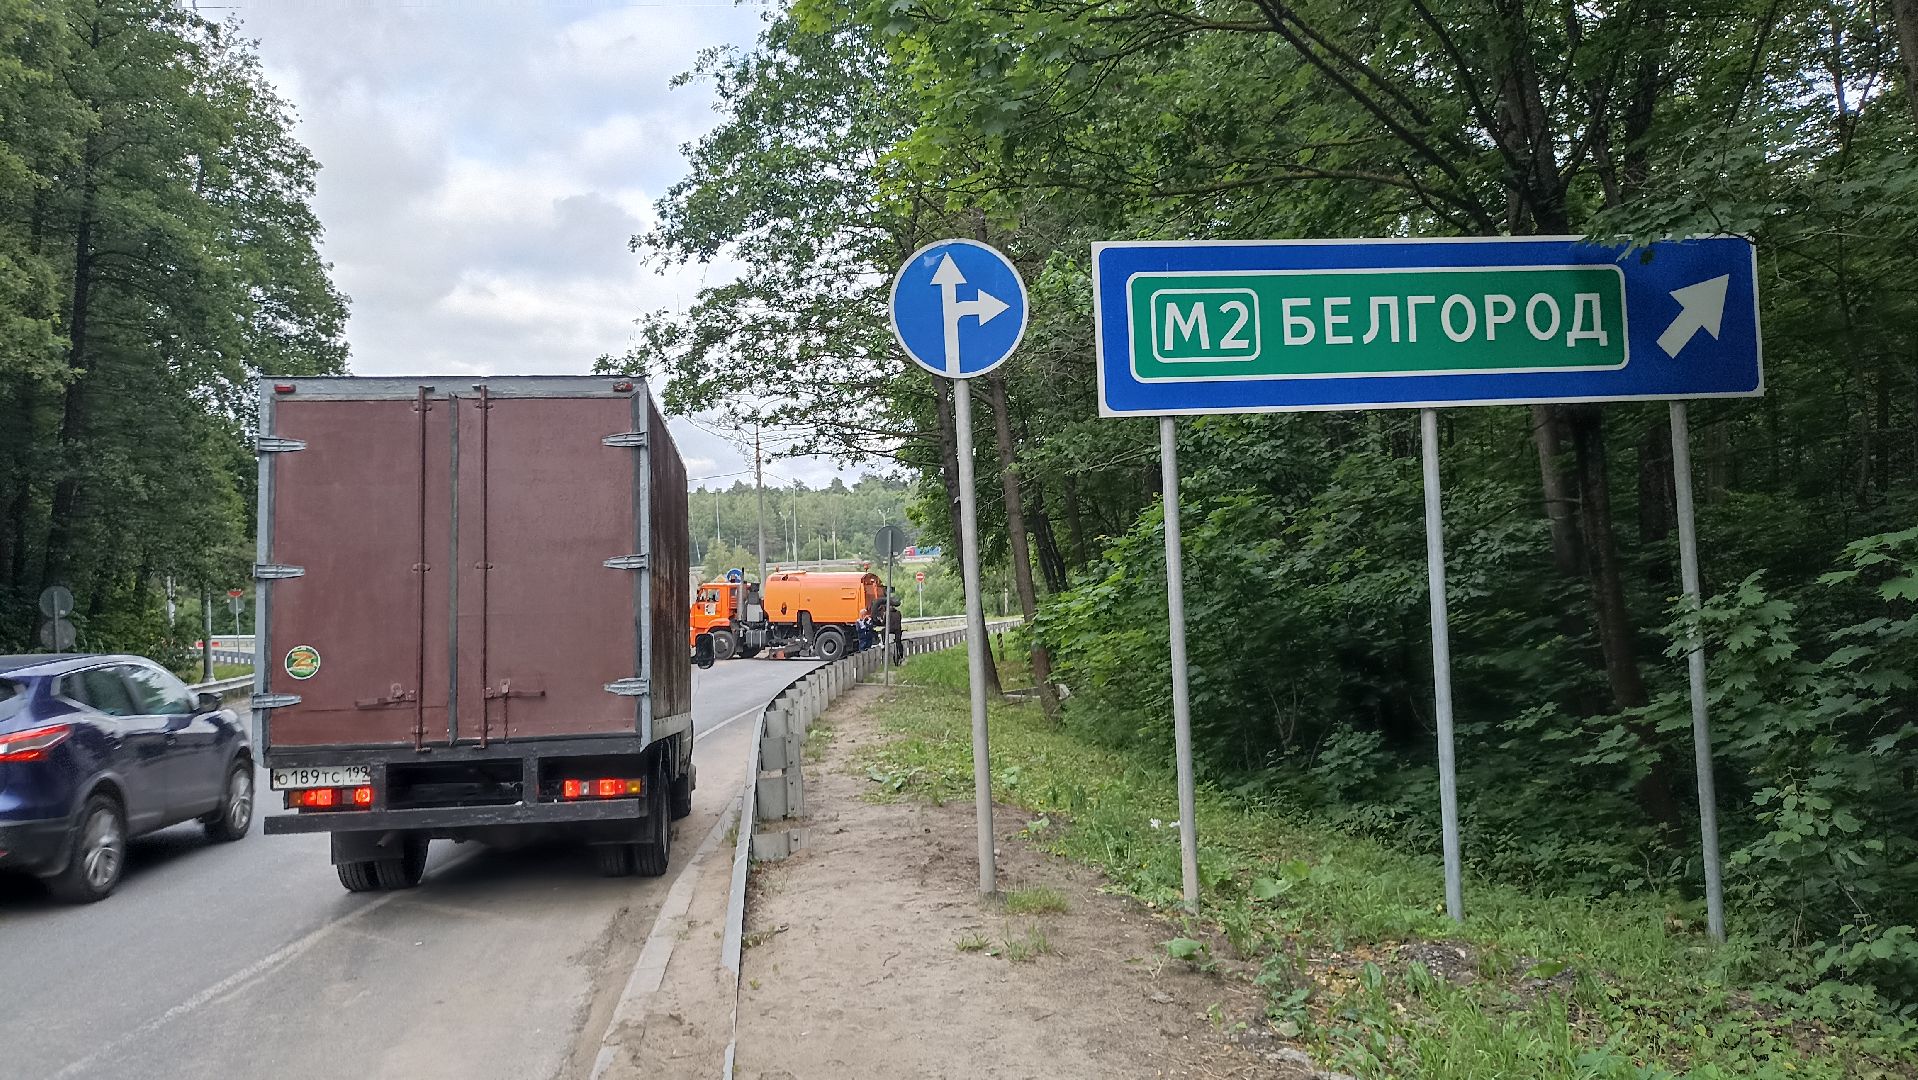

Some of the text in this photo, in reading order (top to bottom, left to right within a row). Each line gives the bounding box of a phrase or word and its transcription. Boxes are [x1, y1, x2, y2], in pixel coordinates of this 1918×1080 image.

[1164, 292, 1608, 350] М2 БЕЛГОРОД
[291, 651, 317, 668] Z
